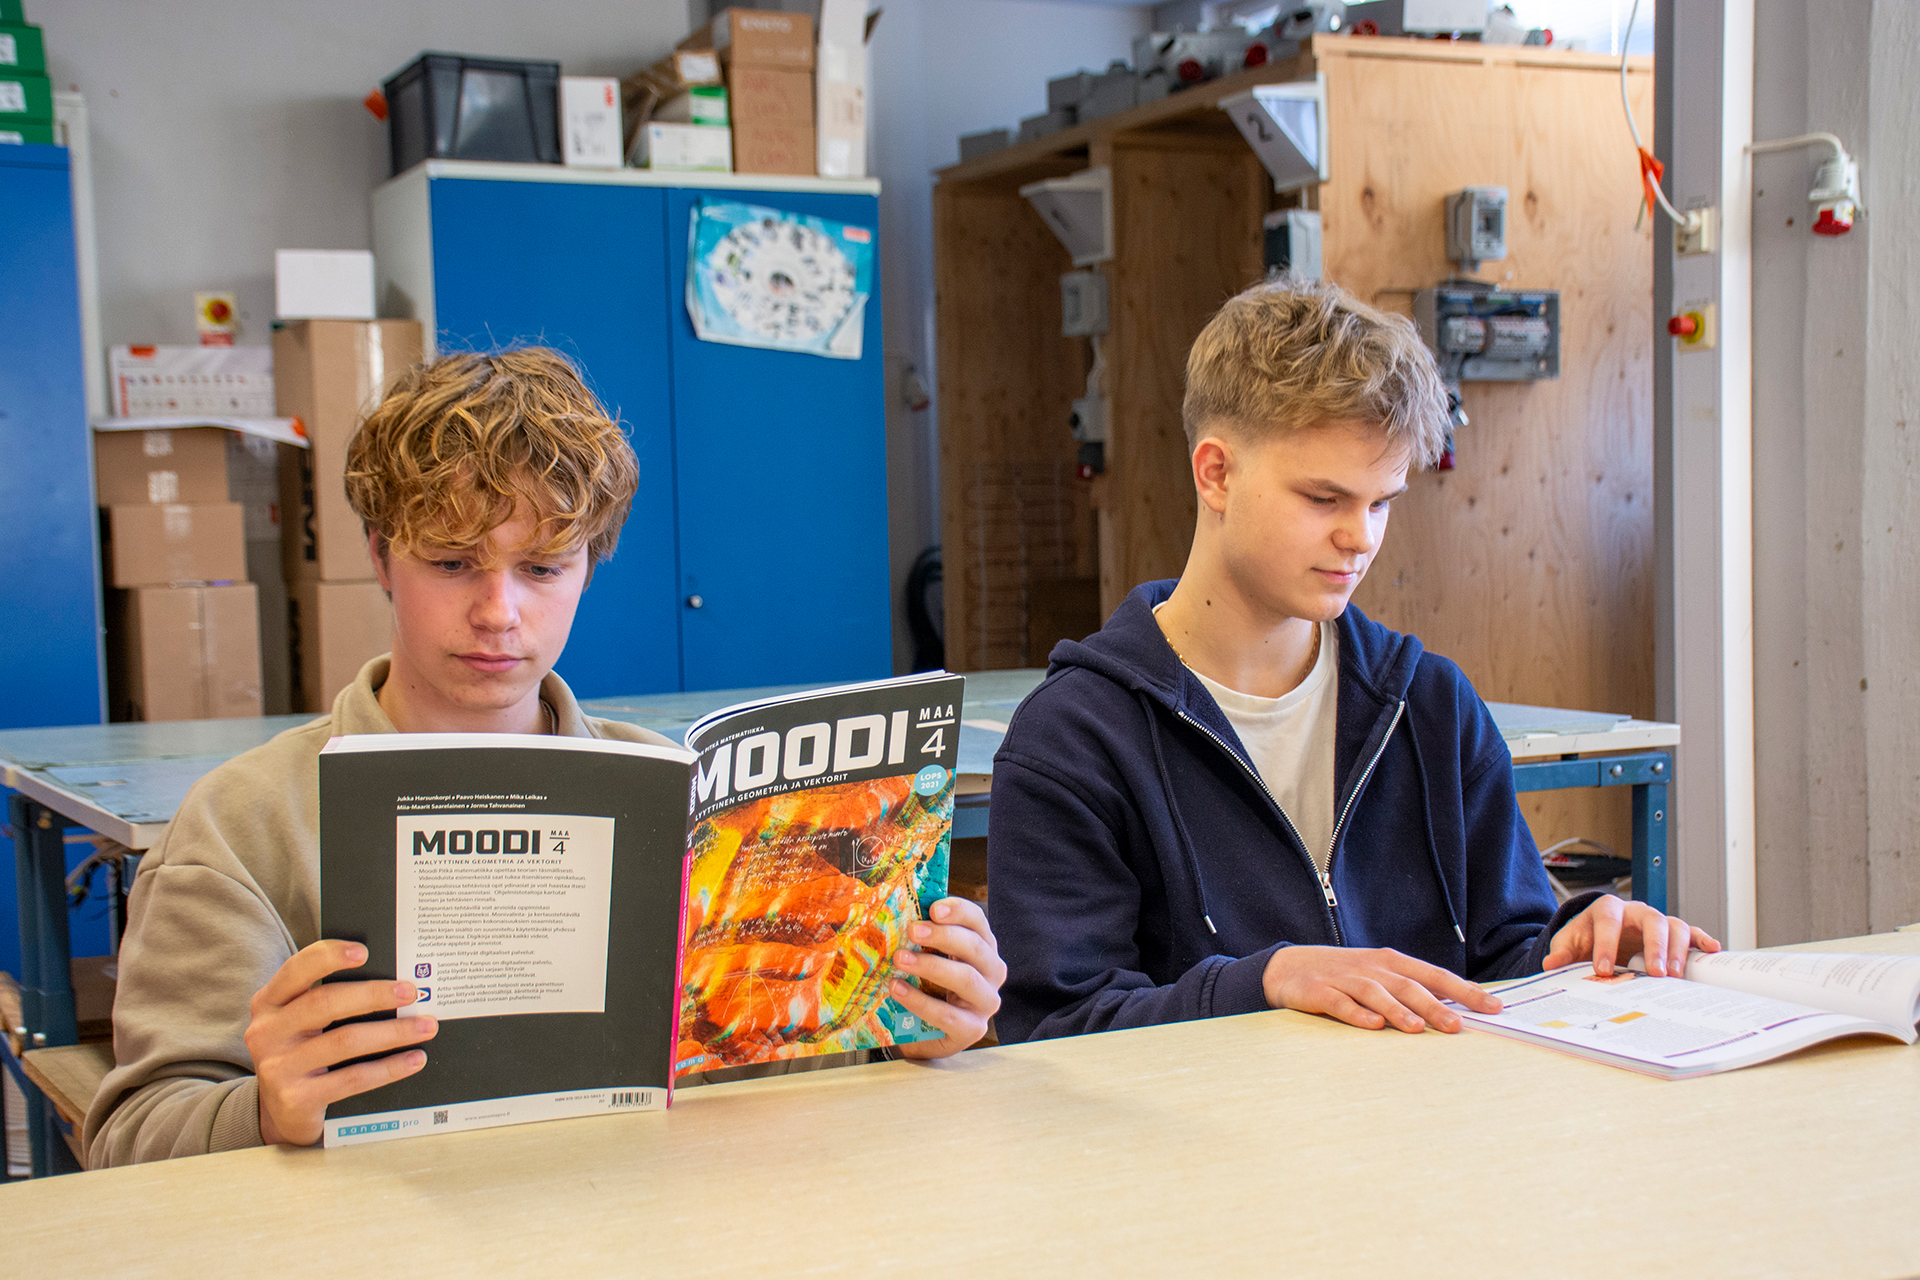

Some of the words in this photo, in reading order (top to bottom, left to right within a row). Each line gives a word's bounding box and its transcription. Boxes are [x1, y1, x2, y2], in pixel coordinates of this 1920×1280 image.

[1247, 112, 1273, 142] 2
[919, 704, 954, 720] MAA
[705, 740, 720, 753] PITKÄ
[720, 725, 765, 744] MATEMATIIKKA
[920, 728, 946, 758] 4
[697, 710, 909, 803] MOODI
[920, 772, 942, 781] LOPS
[920, 781, 939, 790] 2021
[695, 797, 736, 821] LYYTTINEN
[738, 783, 788, 802] GEOMETRIA
[791, 781, 801, 790] JA
[804, 773, 848, 786] VEKTORIT
[413, 830, 541, 856] MOODI
[552, 841, 566, 855] 4
[708, 1053, 723, 1062] pro
[340, 1121, 398, 1136] sanoma
[402, 1119, 419, 1128] pro
